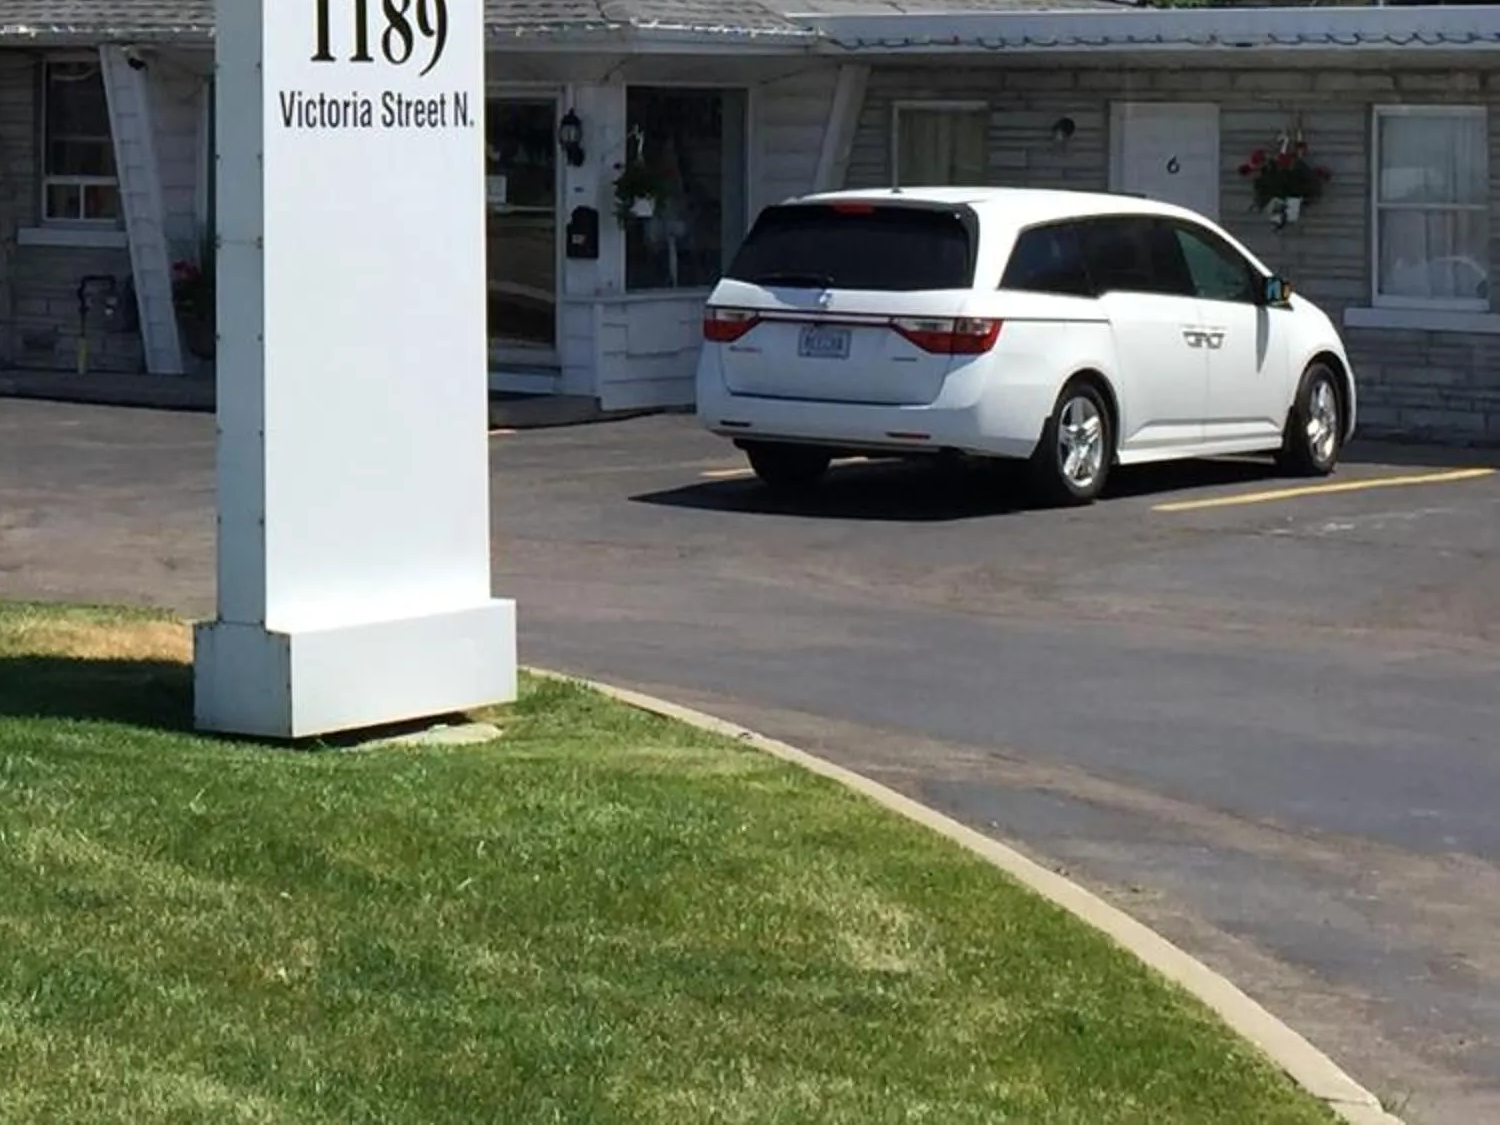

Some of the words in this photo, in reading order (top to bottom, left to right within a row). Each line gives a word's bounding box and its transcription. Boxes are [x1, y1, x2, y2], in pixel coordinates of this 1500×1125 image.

[279, 90, 373, 128] Victoria
[381, 90, 447, 128] Street
[454, 91, 475, 127] N.
[1166, 154, 1181, 175] 6
